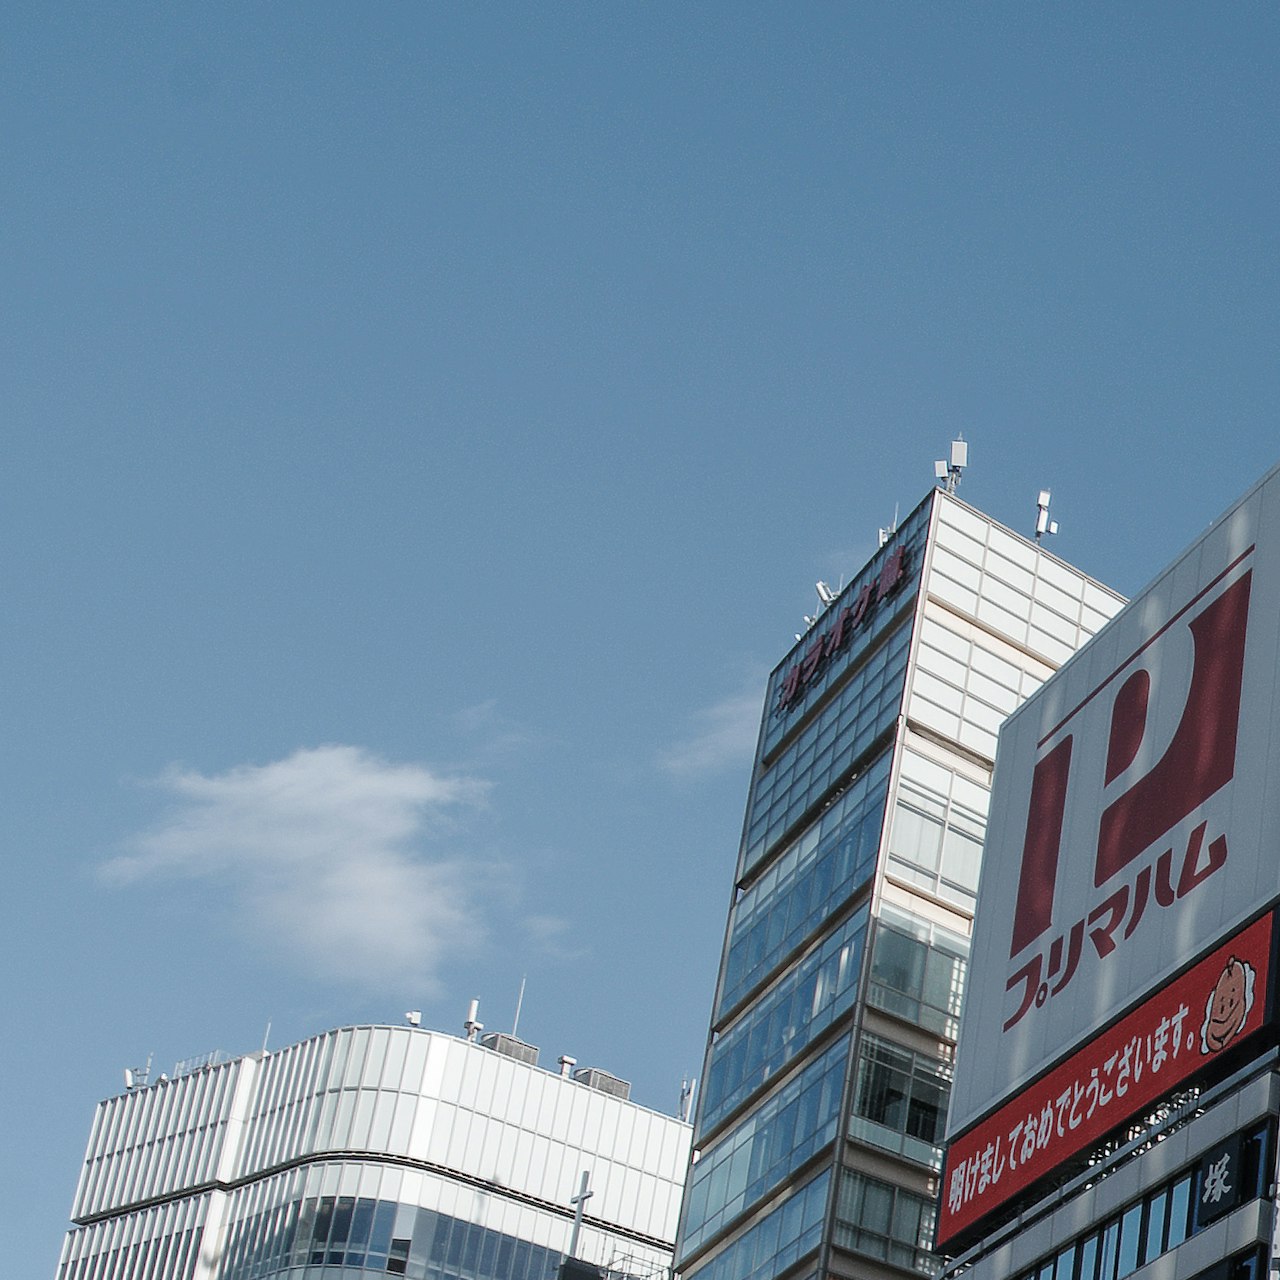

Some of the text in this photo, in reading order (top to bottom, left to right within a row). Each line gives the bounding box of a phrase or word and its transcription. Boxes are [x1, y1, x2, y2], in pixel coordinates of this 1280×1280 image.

[1003, 822, 1228, 1033] プリマハム
[948, 1003, 1195, 1215] 明けましておめでとうございます。
